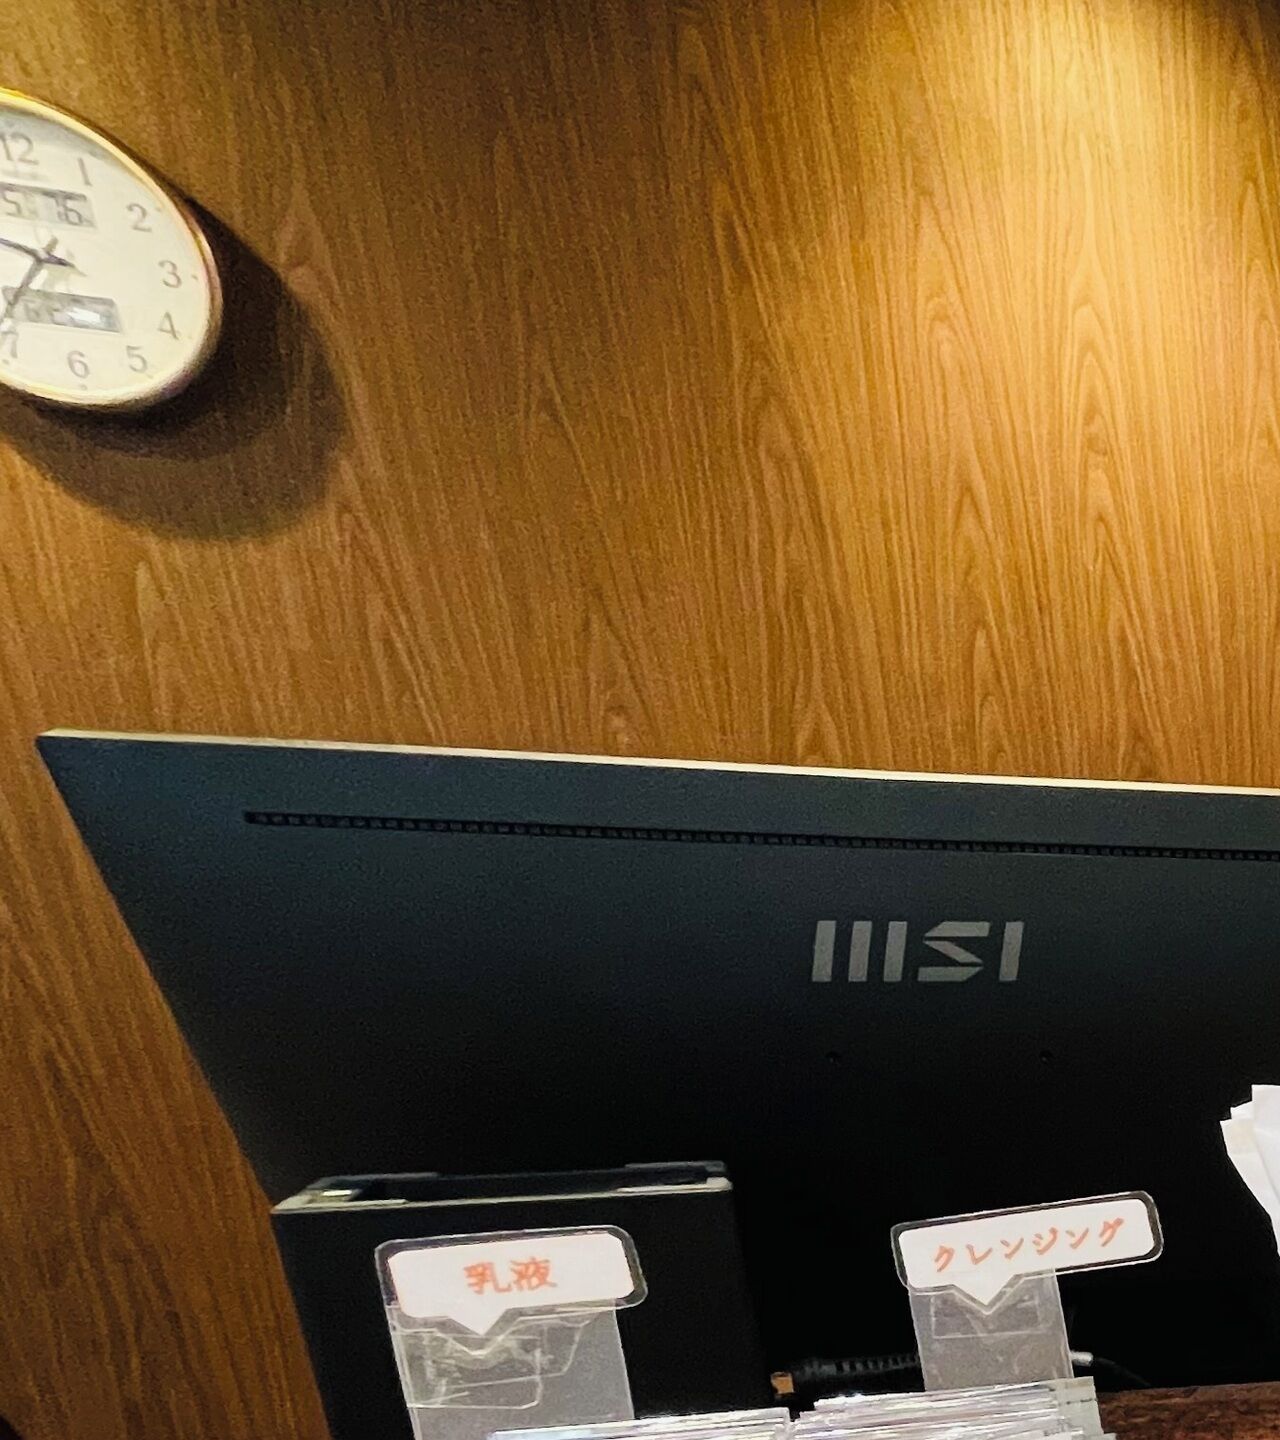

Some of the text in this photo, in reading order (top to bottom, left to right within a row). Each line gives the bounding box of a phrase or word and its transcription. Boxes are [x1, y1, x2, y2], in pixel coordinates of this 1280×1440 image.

[0, 131, 39, 166] 12
[77, 157, 92, 187] 1
[126, 203, 152, 233] 2
[158, 260, 182, 289] 3
[158, 312, 180, 341] 4
[67, 350, 90, 380] 6
[126, 345, 148, 373] 5
[812, 920, 1024, 982] MSI
[934, 1217, 1124, 1272] クレンジング
[464, 1256, 557, 1295] 乳液
